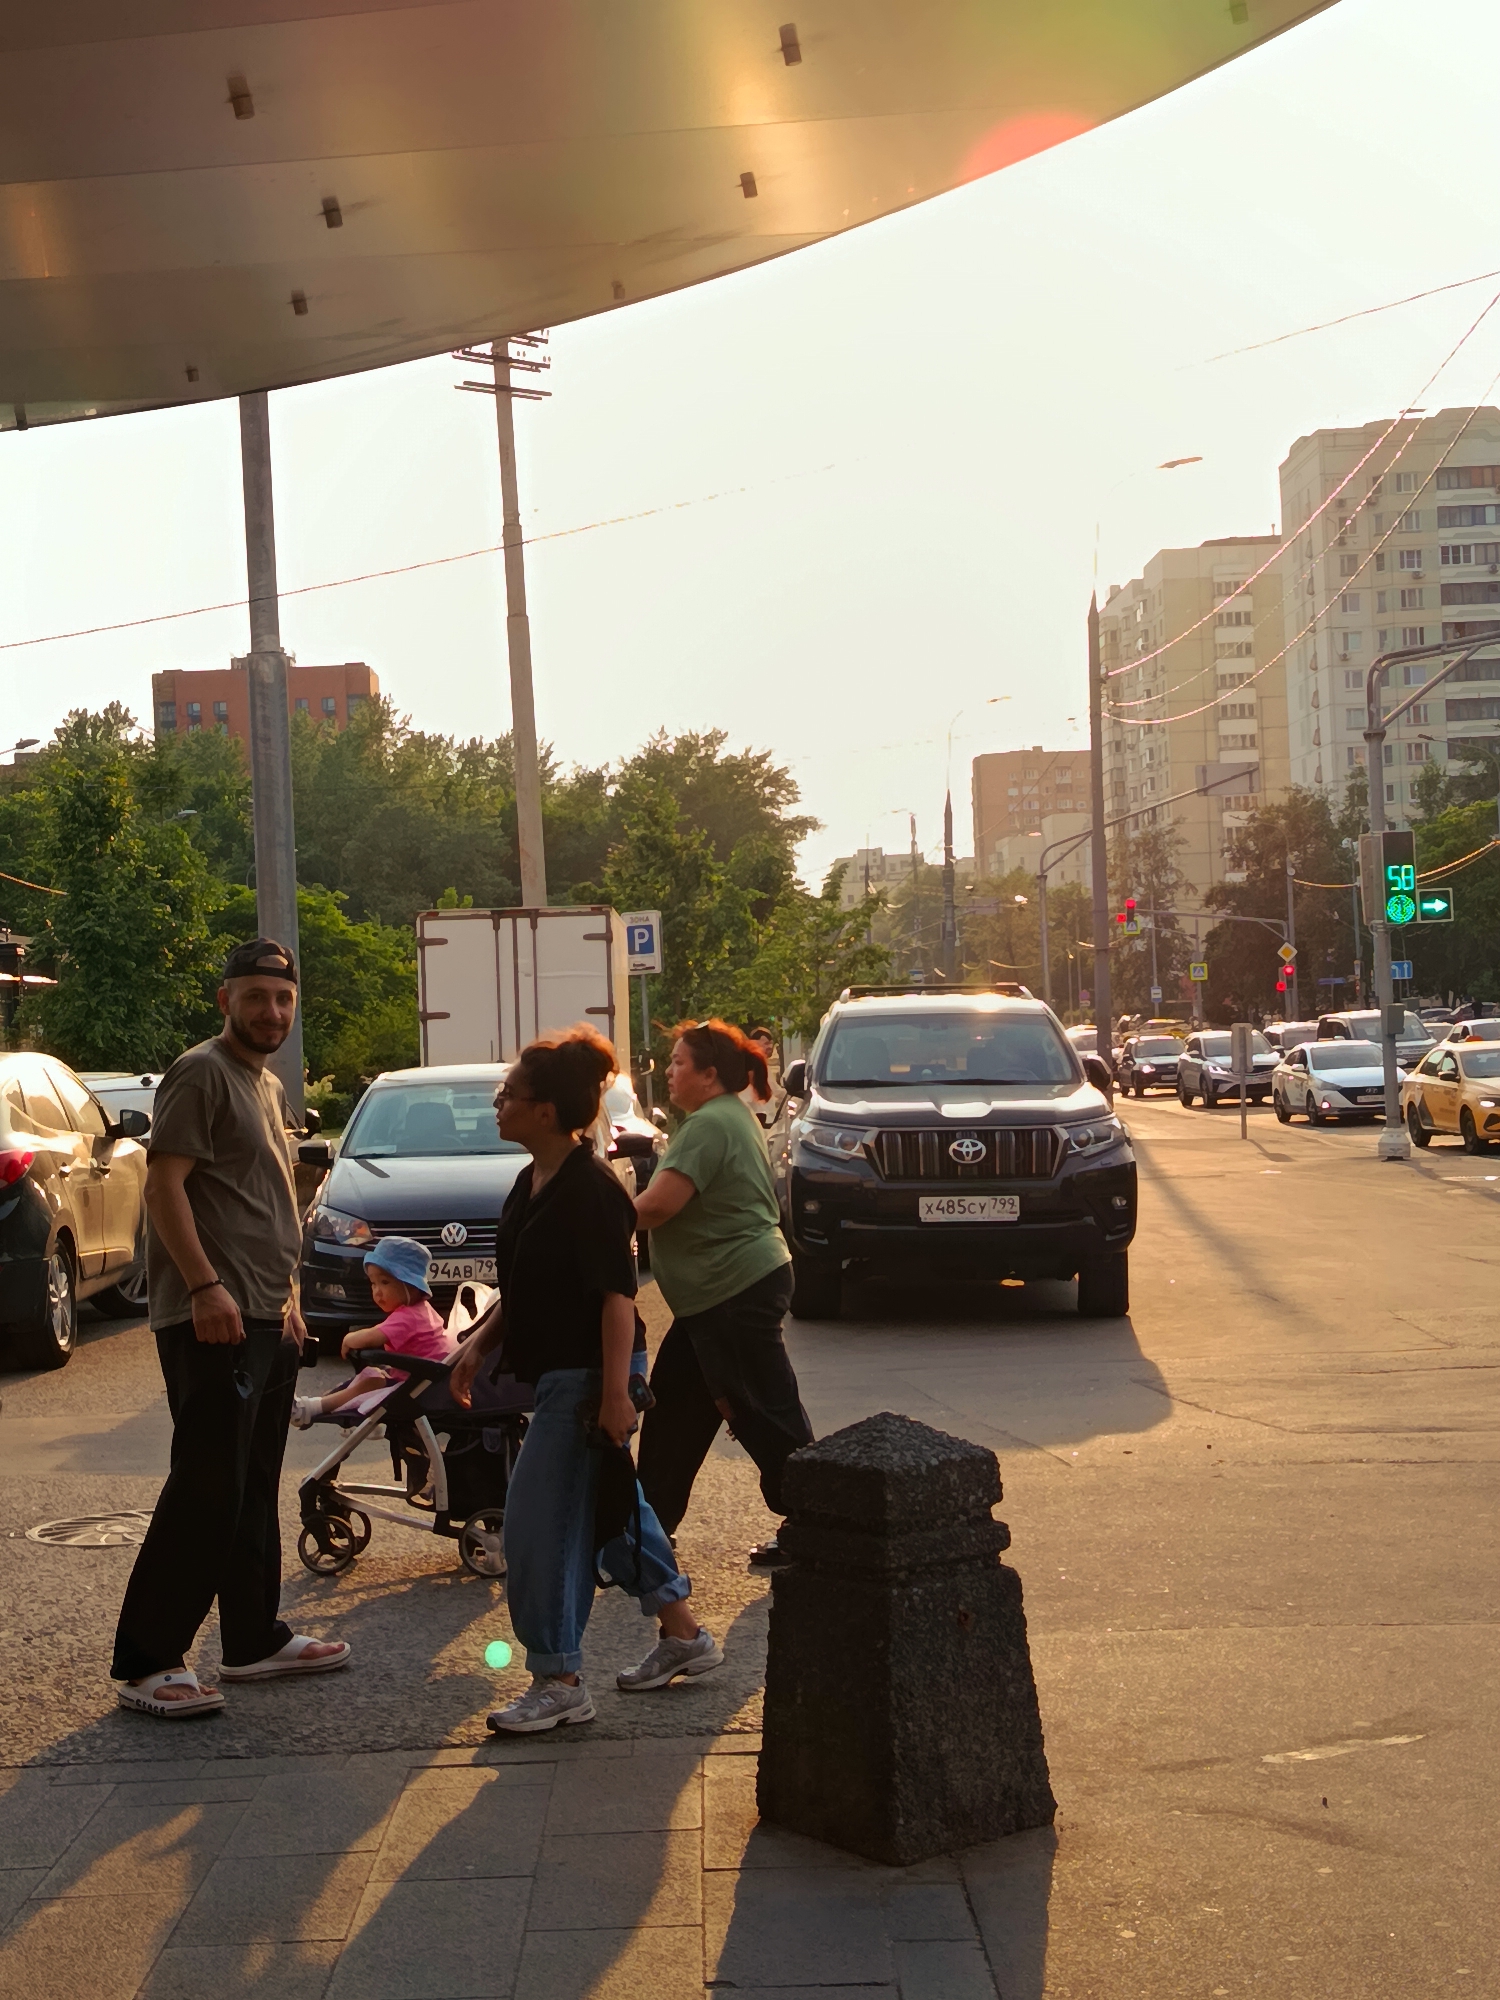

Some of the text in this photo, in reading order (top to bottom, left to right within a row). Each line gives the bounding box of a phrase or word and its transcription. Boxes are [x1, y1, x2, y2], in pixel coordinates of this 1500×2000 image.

[1387, 864, 1414, 890] 58
[634, 928, 649, 951] P
[925, 1197, 1015, 1214] Х485СУ 799
[429, 1260, 497, 1279] 94АВ 79
